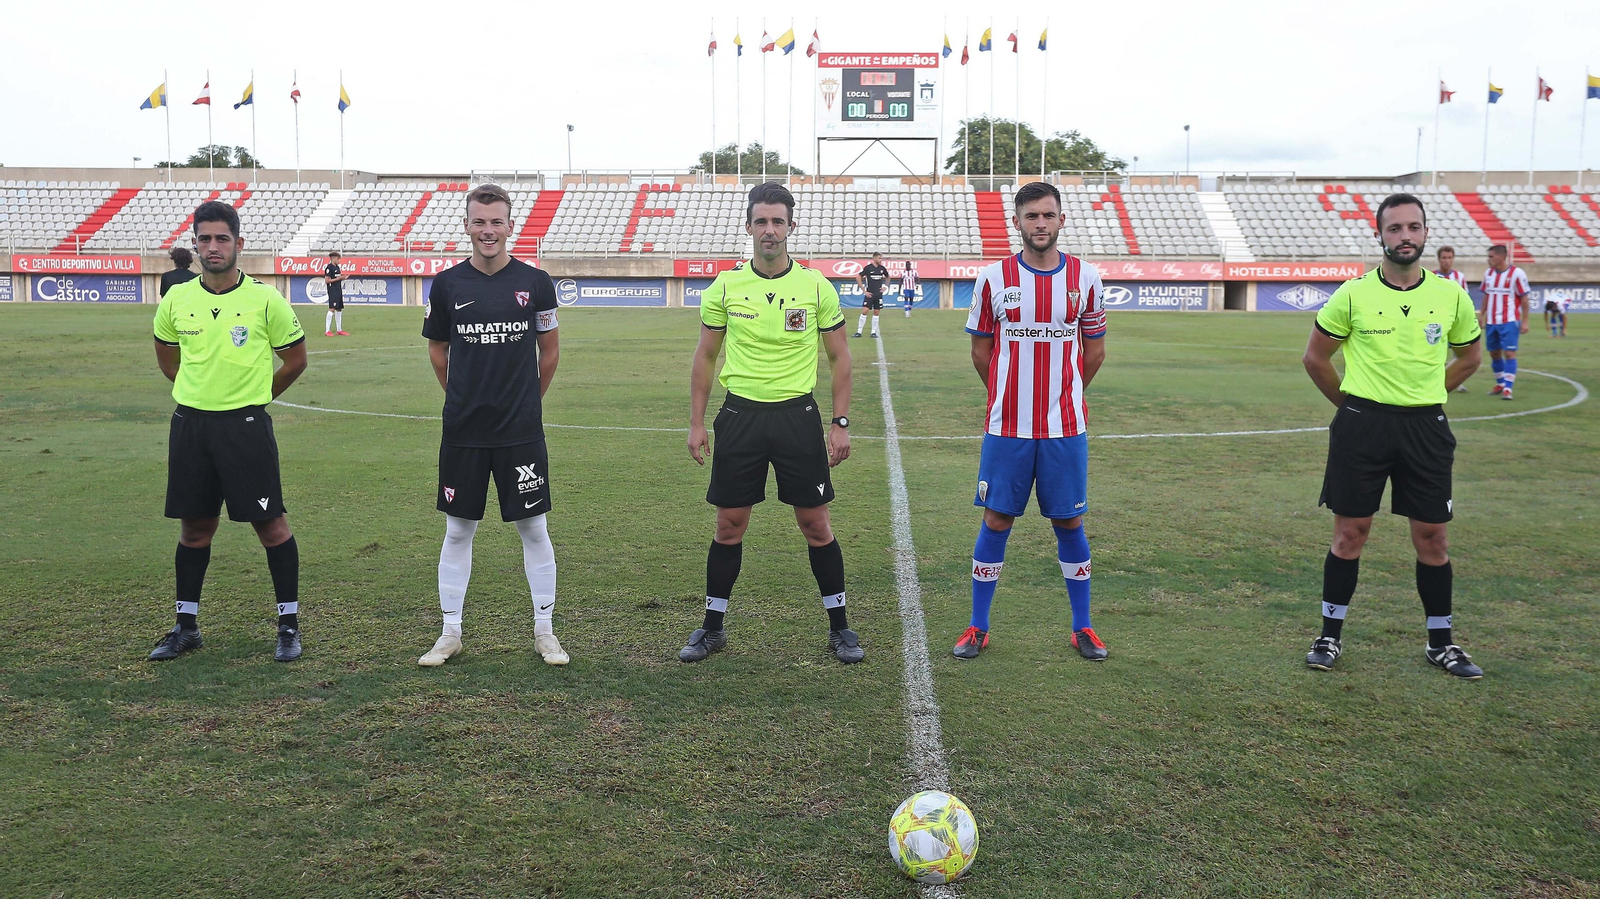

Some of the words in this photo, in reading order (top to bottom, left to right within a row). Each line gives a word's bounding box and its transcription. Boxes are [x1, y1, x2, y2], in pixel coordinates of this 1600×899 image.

[827, 56, 871, 65] GIGANTE
[881, 54, 936, 65] EMPEÑOS
[32, 258, 60, 269] CENTRO
[61, 259, 101, 269] DEPORTIVO
[103, 259, 113, 269] LA
[113, 259, 135, 270] VILLA
[281, 257, 308, 273] Pepe
[310, 257, 356, 273] Vancia
[1229, 266, 1291, 277] HOTELES
[1292, 265, 1358, 277] ALBORÁN
[37, 276, 100, 301] Castro
[57, 276, 74, 290] de
[582, 288, 661, 297] EUROGRUAS
[1138, 286, 1204, 296] HYUNDAI
[1138, 297, 1203, 306] PERMOTOR
[456, 320, 529, 335] MARATHON
[1005, 326, 1076, 338] master.house
[480, 333, 508, 344] BET
